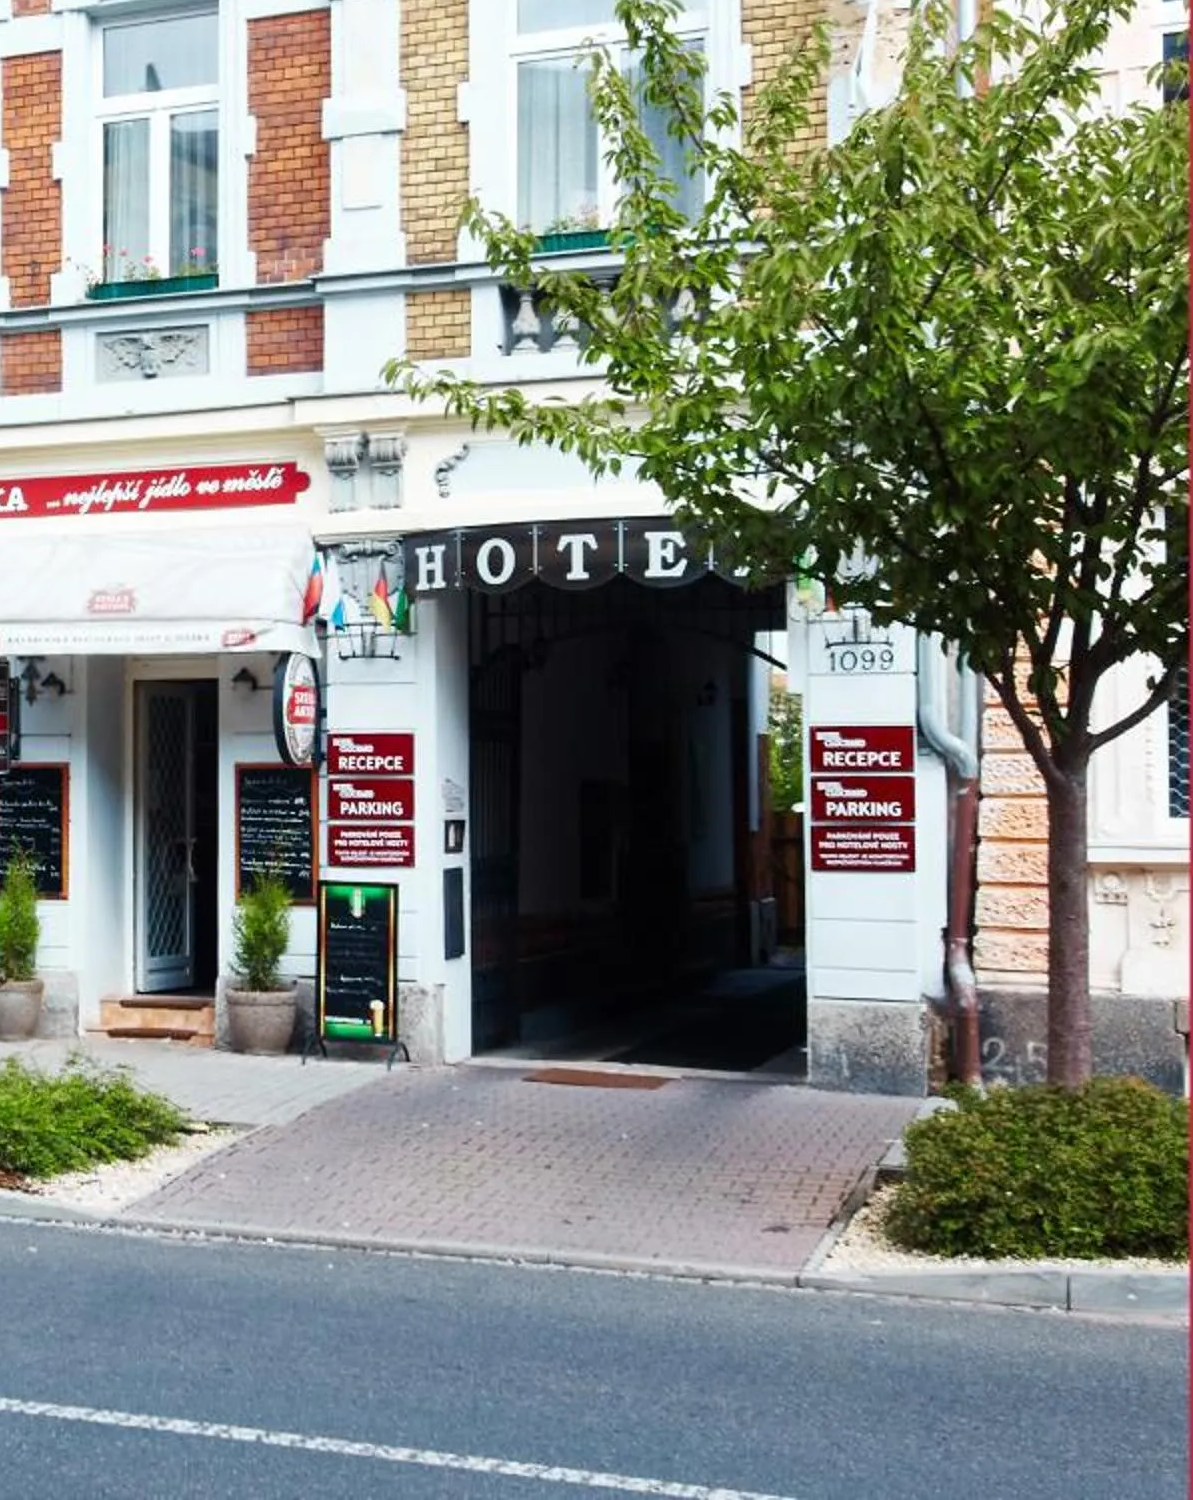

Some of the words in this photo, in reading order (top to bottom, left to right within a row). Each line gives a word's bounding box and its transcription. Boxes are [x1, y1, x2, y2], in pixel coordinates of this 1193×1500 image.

[63, 479, 143, 515] nejlepší
[139, 472, 192, 509] jídlo
[196, 479, 218, 495] ve
[222, 466, 285, 494] městě
[414, 530, 754, 592] HOTE
[829, 648, 894, 672] 1099
[338, 755, 404, 771] RECEPCE
[822, 751, 902, 767] RECEPCE
[340, 801, 404, 816] PARKING
[826, 801, 902, 817] PARKING
